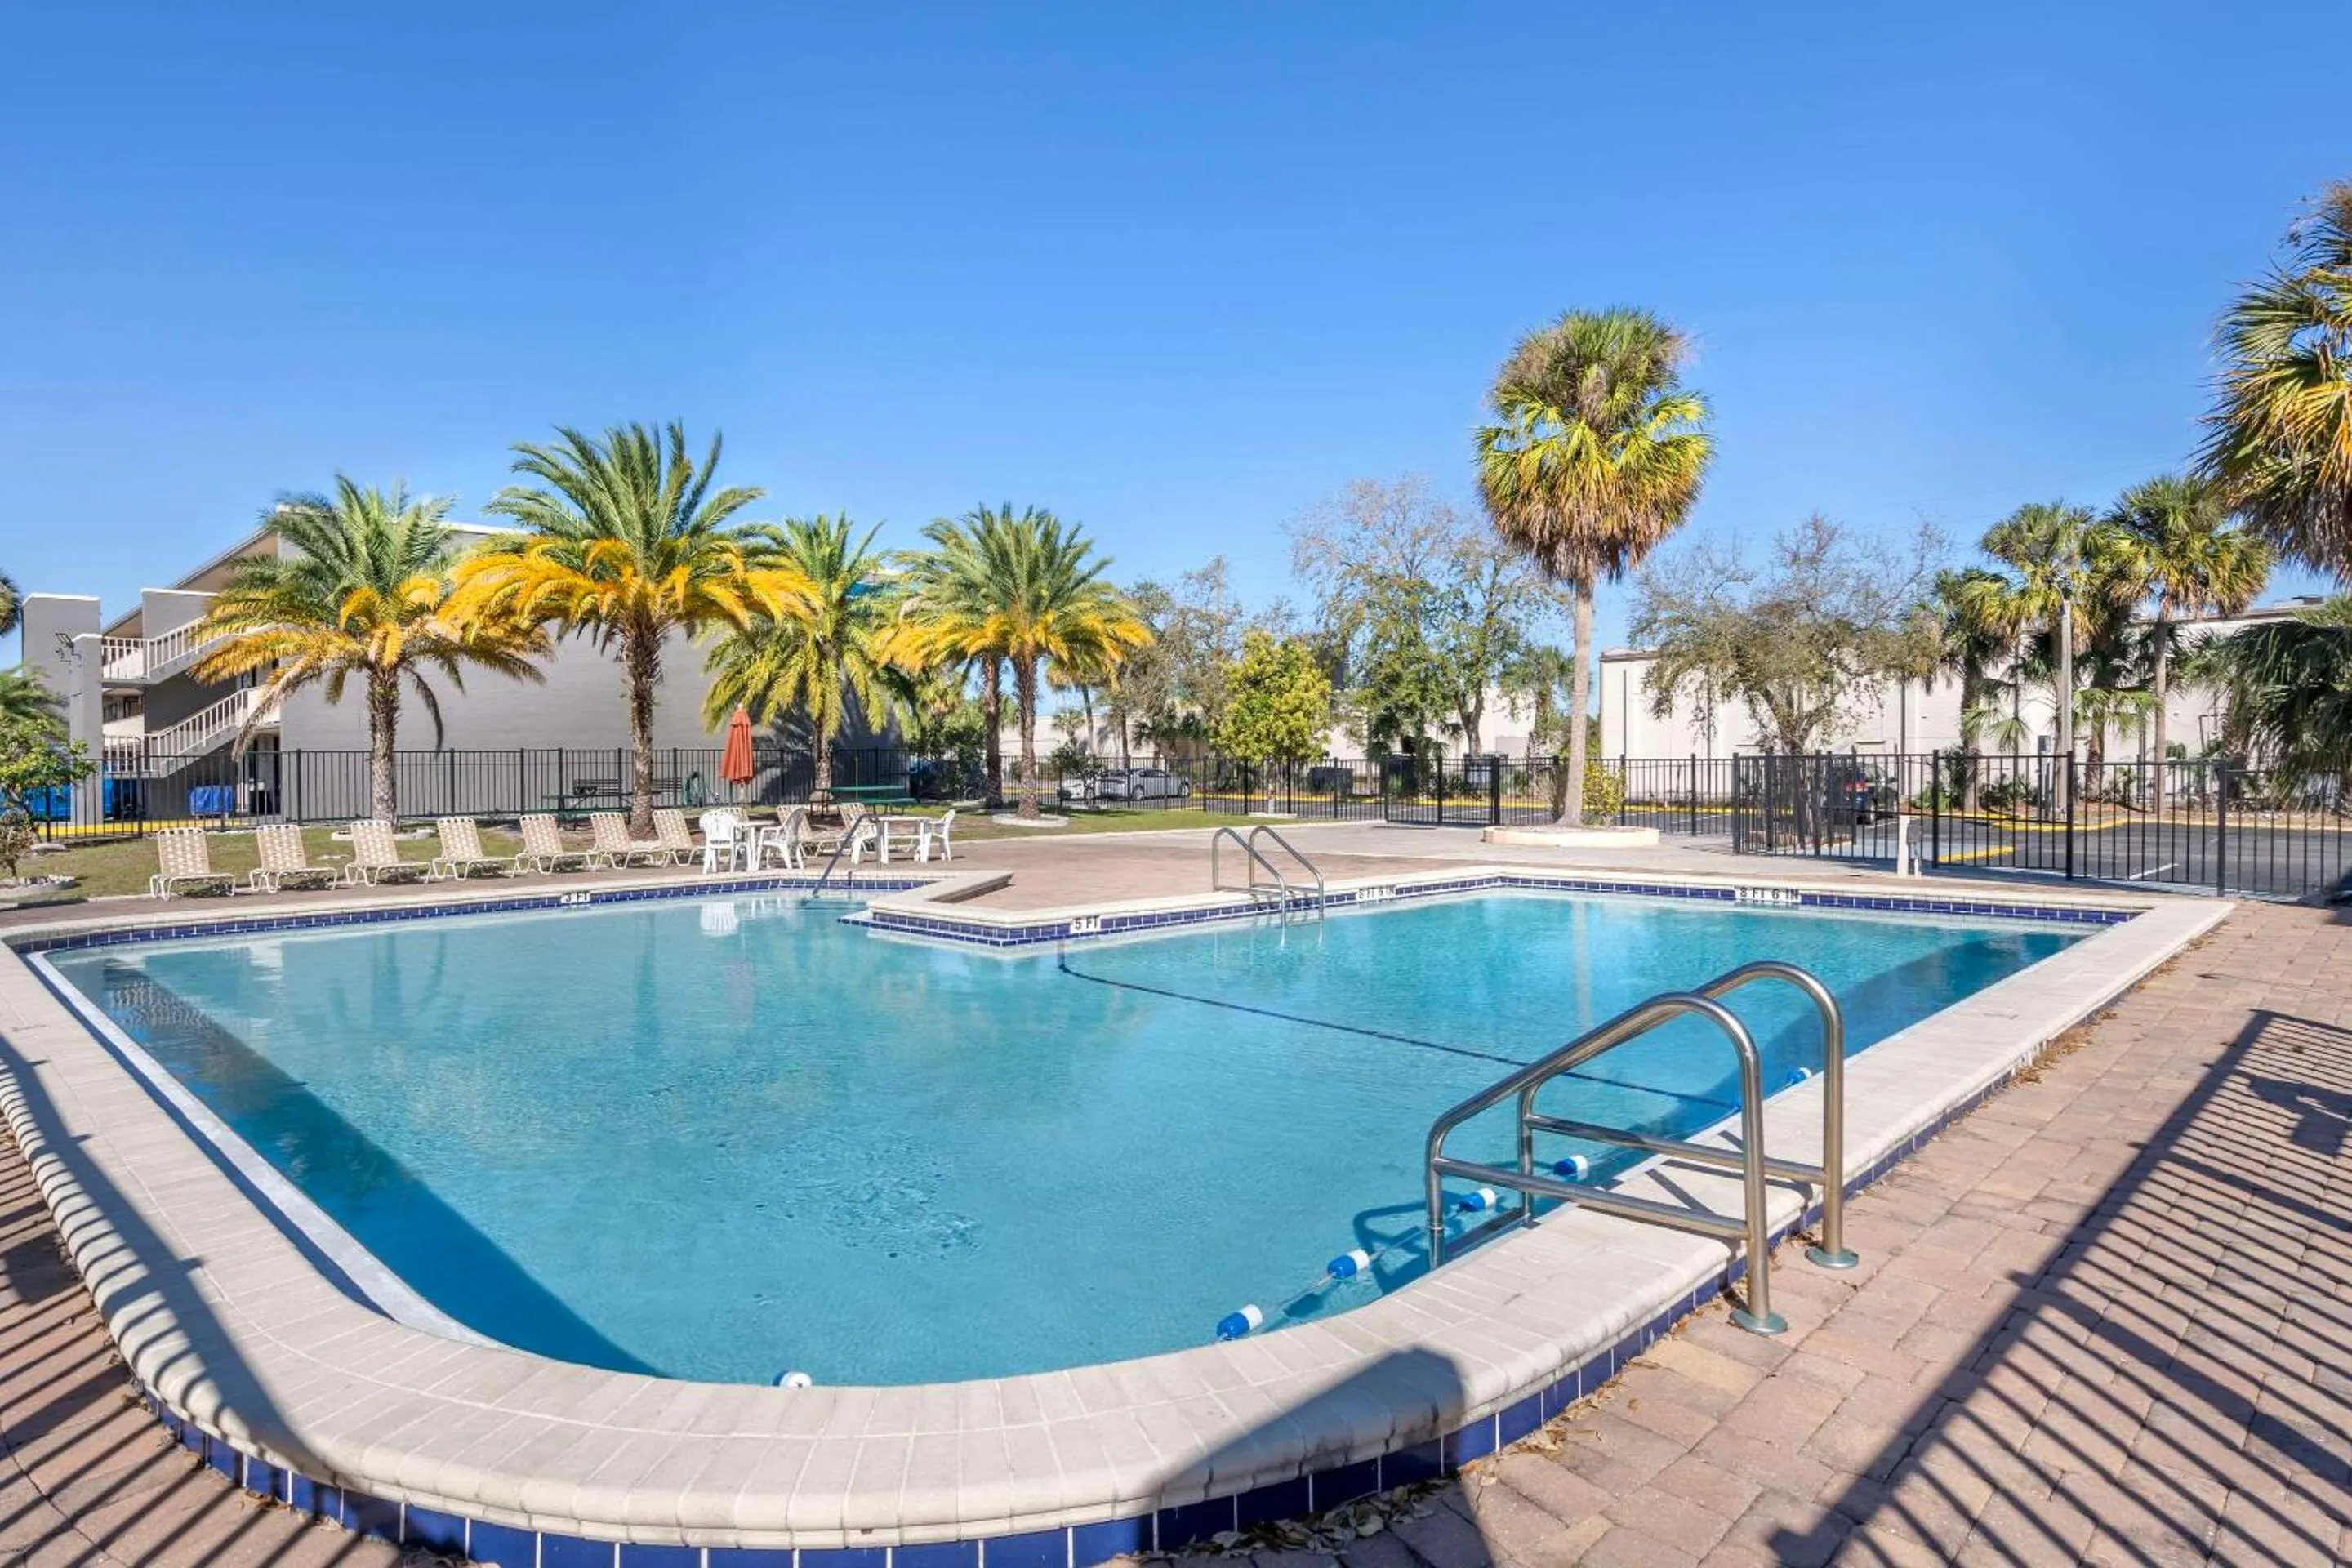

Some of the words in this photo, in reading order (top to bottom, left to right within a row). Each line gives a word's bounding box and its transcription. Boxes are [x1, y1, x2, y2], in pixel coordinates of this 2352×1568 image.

[577, 890, 590, 902] FT
[1740, 887, 1748, 898] 8
[1753, 887, 1765, 898] FT
[1771, 888, 1780, 900] 6
[1786, 888, 1799, 900] IN
[1075, 915, 1082, 930] 5
[1086, 915, 1100, 929] FT
